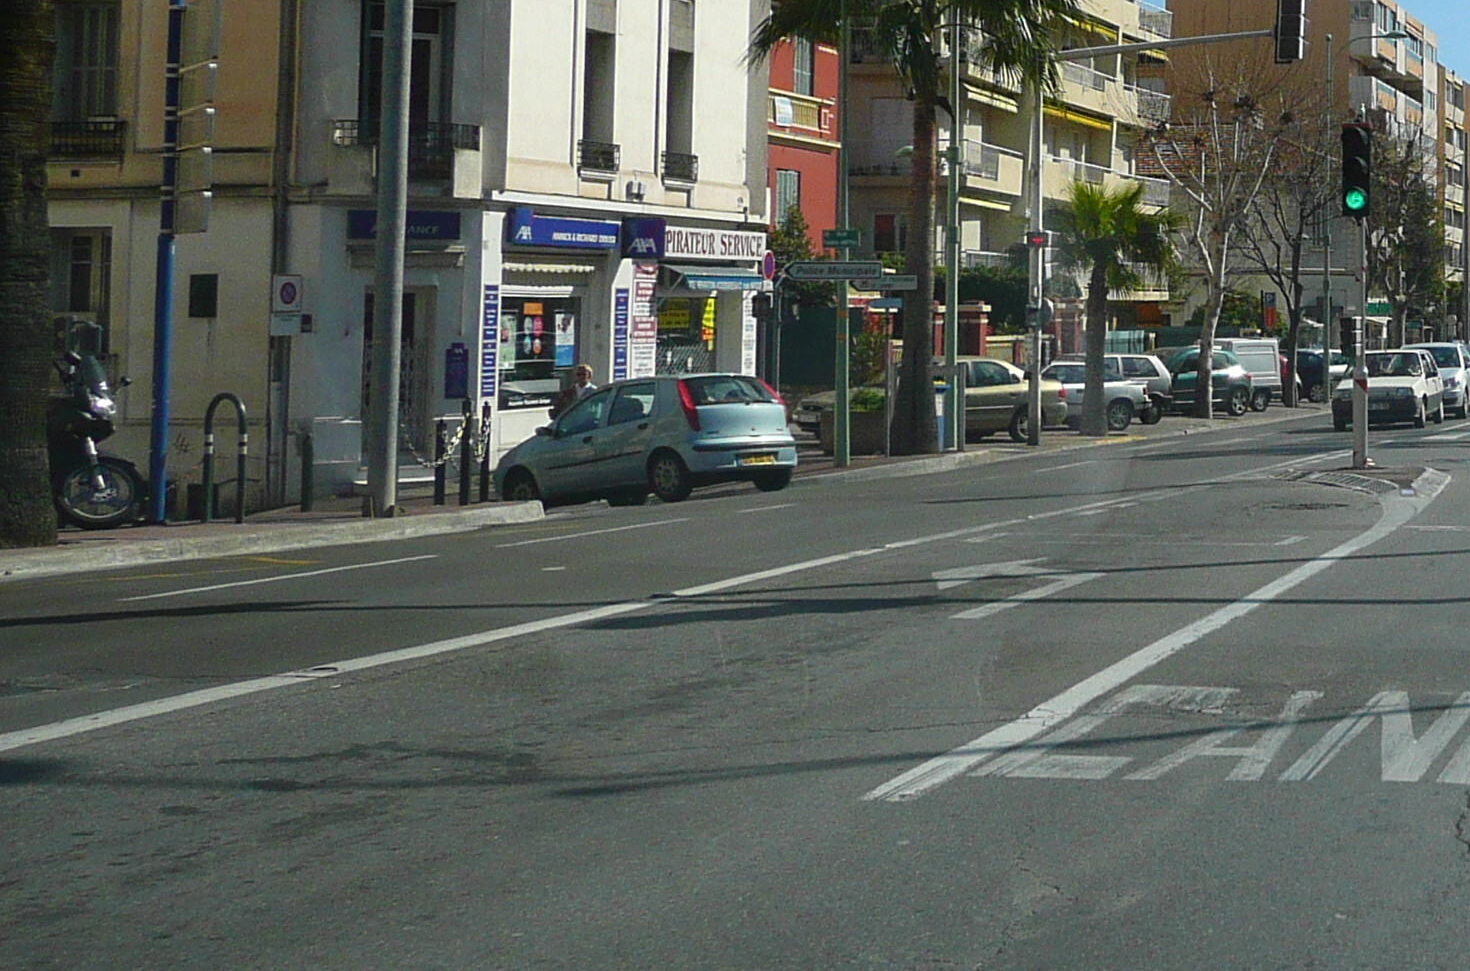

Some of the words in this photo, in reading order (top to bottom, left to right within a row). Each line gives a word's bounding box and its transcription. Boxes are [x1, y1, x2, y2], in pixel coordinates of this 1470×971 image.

[627, 237, 657, 253] AXA
[666, 230, 715, 255] PIRATEUR
[720, 233, 763, 257] SERVICE
[797, 266, 824, 275] Police
[827, 266, 877, 276] Municipale
